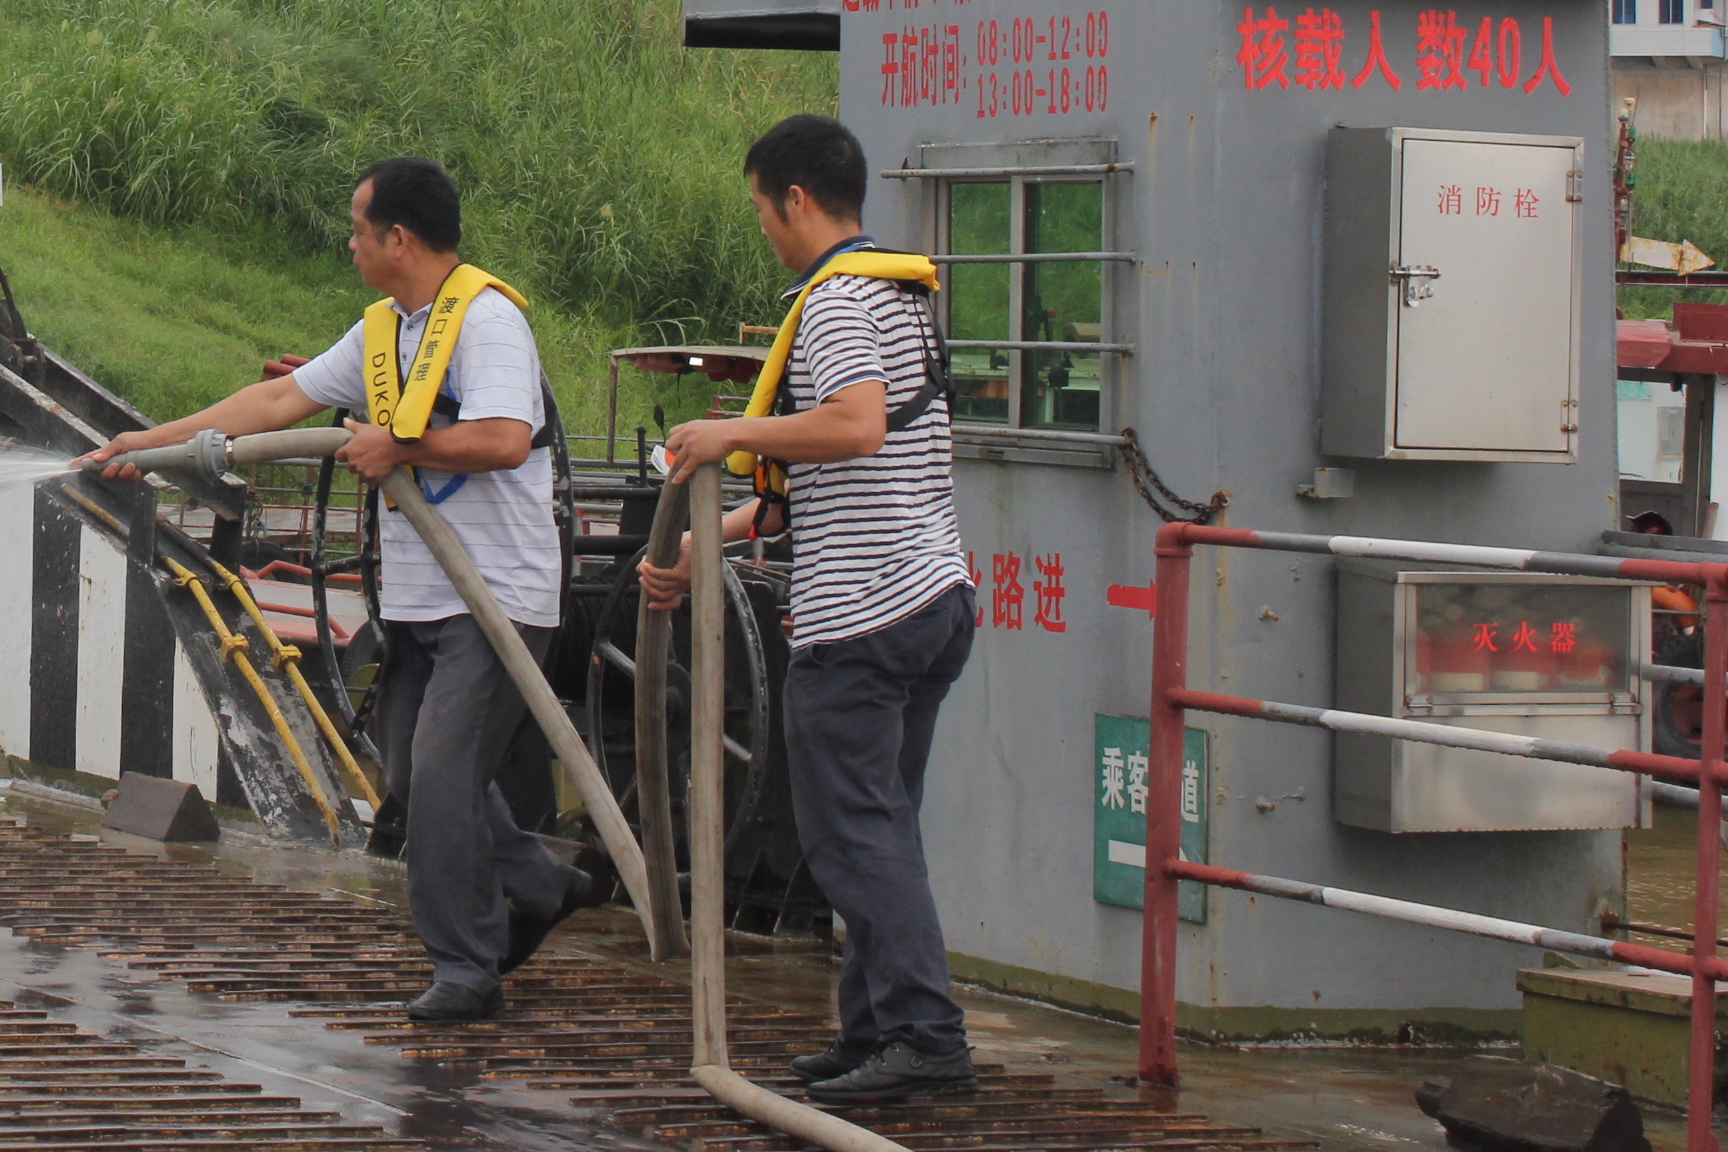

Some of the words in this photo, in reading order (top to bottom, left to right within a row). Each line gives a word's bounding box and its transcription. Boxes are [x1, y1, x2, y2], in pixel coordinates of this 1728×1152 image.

[977, 10, 1109, 66] 08:00-12:00
[1236, 7, 1572, 98] 核载人数40人
[976, 65, 1109, 118] 13:00-18:00
[1436, 184, 1540, 218] 消防栓
[414, 296, 460, 382] 渡口管理
[1473, 621, 1577, 653] 灭火器
[1101, 746, 1200, 824] 乘客道
